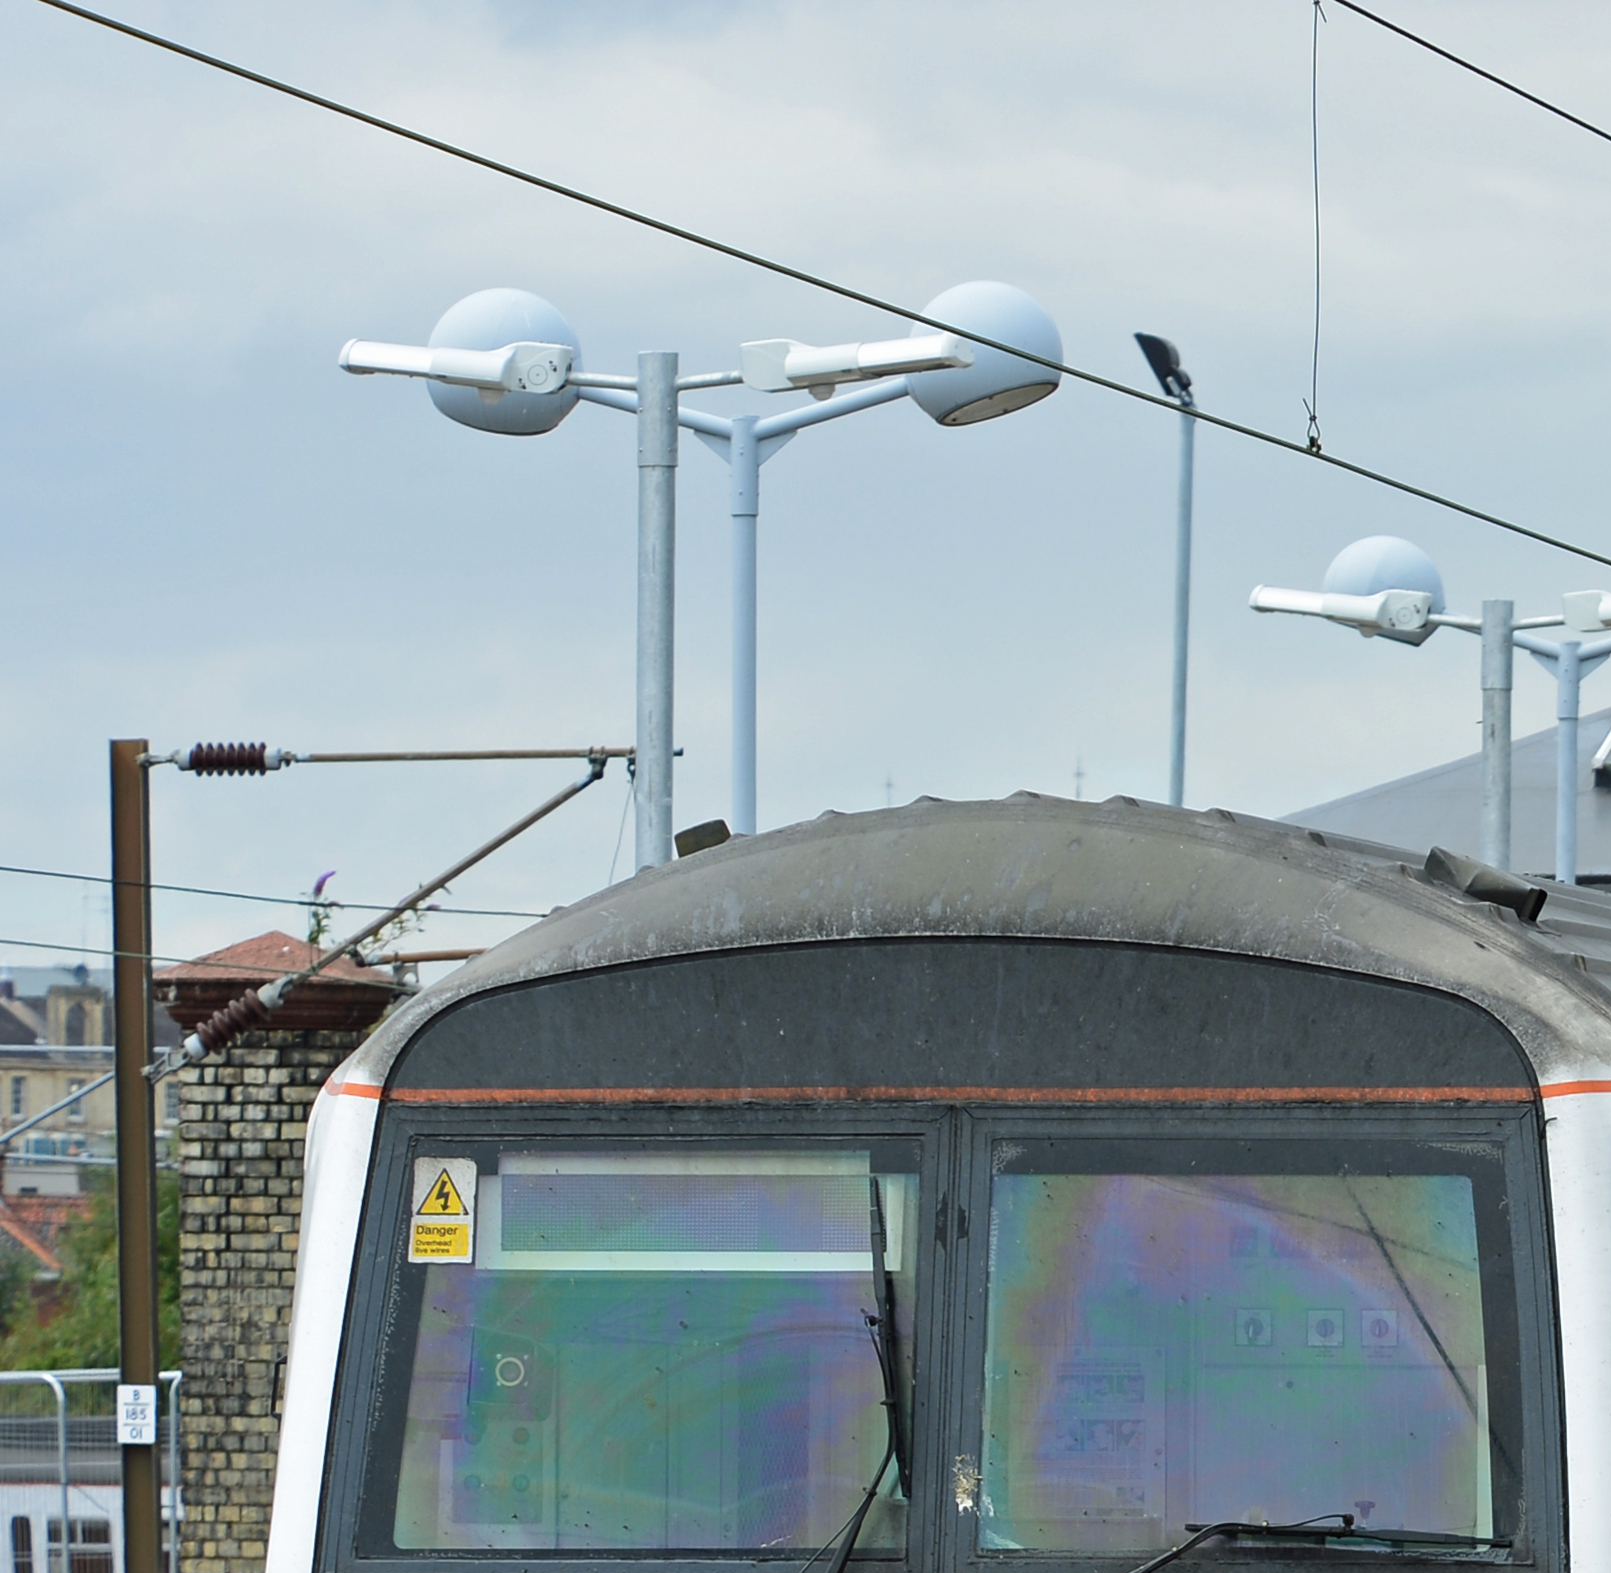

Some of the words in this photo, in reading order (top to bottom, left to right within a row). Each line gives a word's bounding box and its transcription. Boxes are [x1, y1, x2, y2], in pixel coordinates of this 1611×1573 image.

[416, 1225, 458, 1236] Danger
[133, 1389, 140, 1401] B
[126, 1407, 147, 1420] 185
